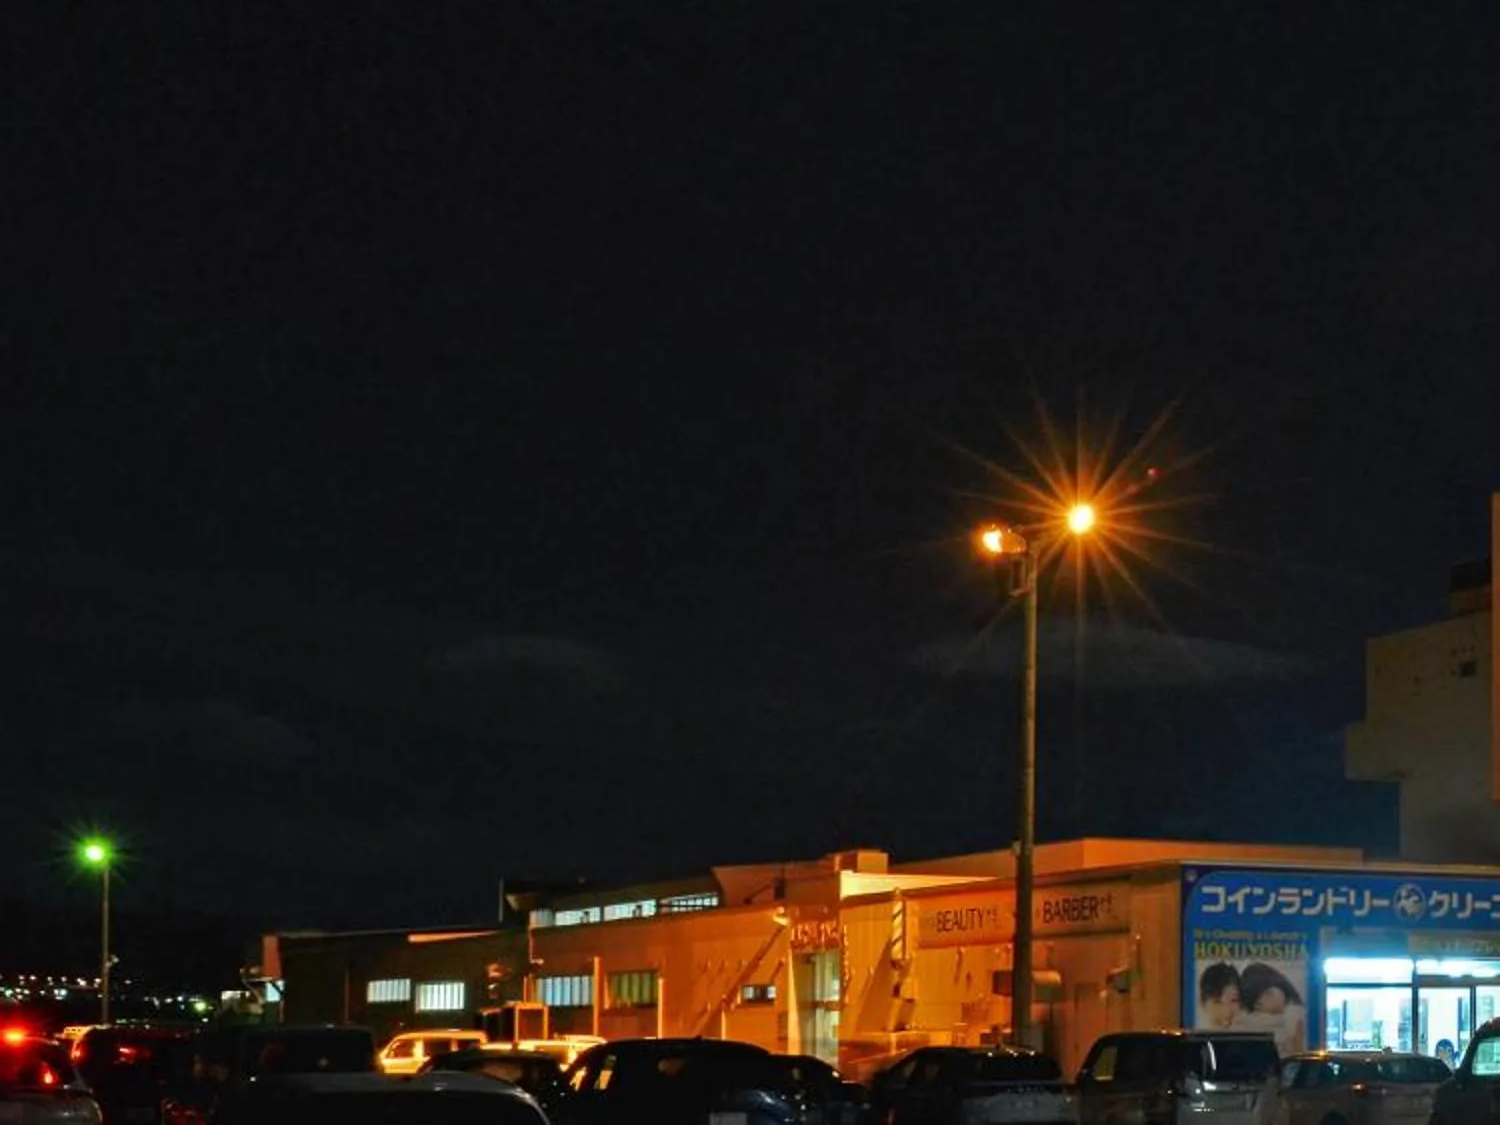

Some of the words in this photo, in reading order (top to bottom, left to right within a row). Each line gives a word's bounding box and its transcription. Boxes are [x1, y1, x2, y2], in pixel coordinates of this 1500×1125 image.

[1043, 896, 1100, 924] BARBER
[1200, 885, 1391, 918] コインランドリー
[935, 908, 984, 932] BEAUTY
